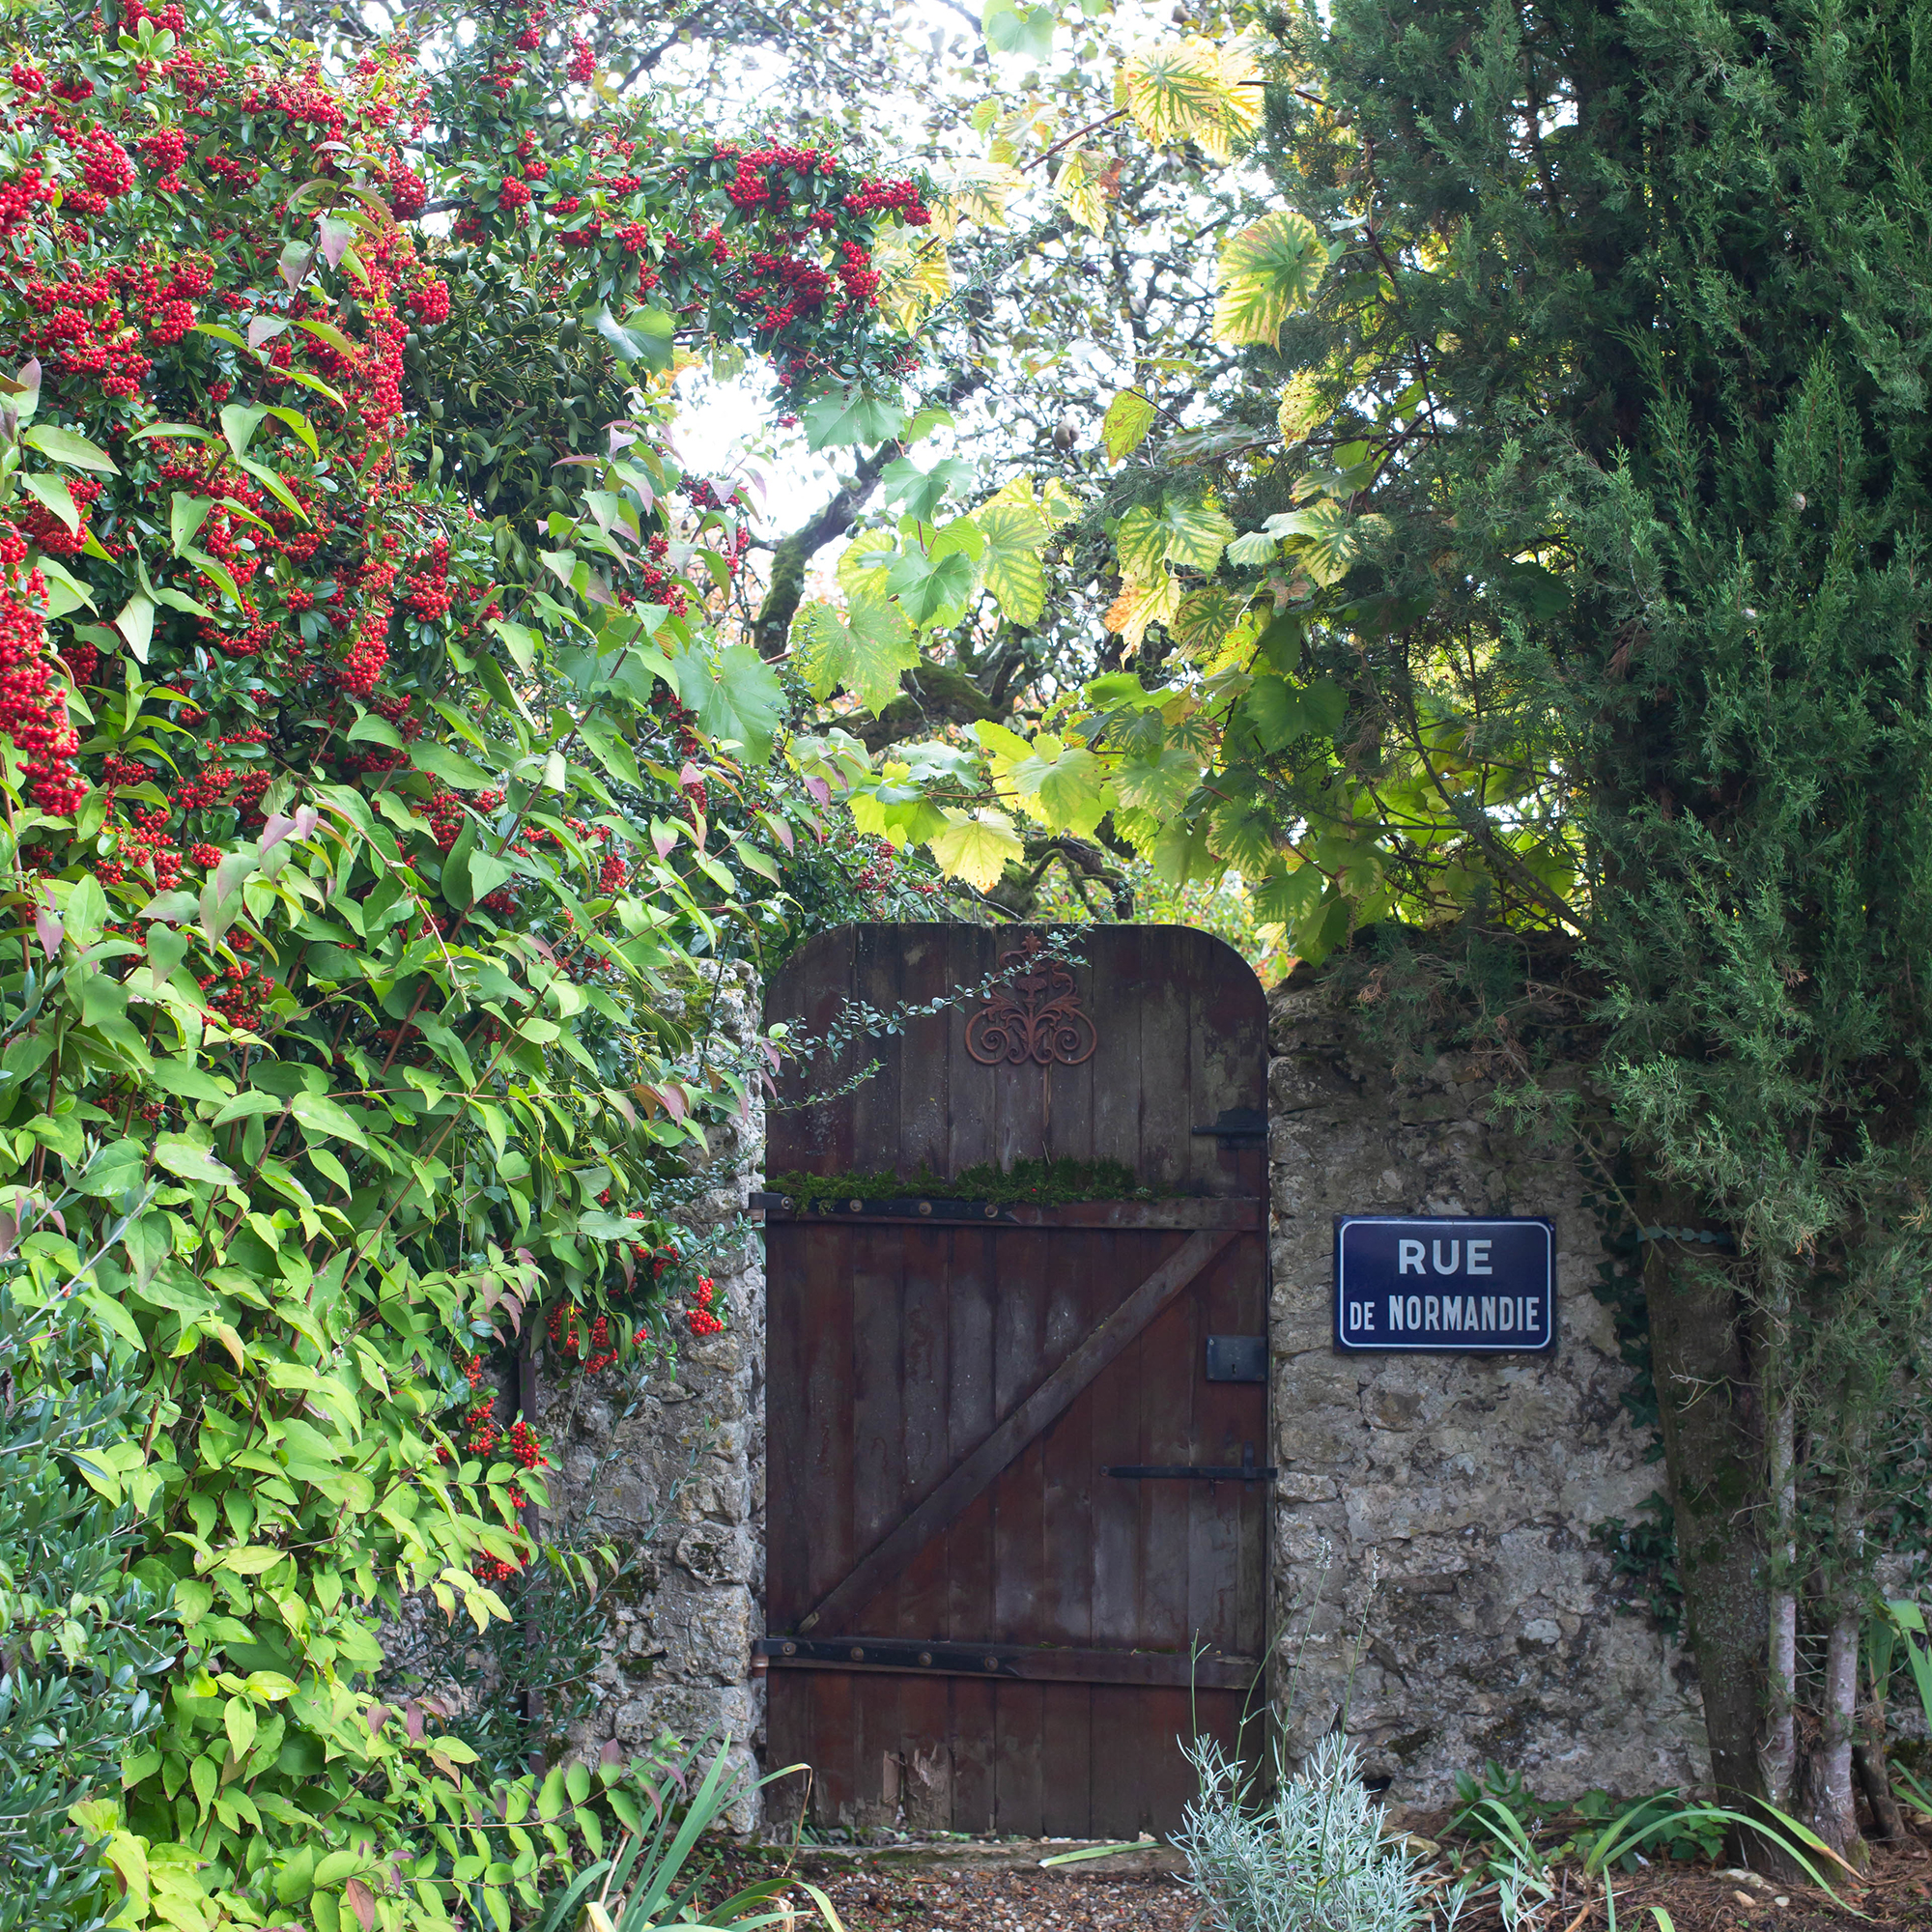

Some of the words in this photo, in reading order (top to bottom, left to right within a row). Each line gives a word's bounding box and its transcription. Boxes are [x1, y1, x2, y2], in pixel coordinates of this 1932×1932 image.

[1398, 1238, 1493, 1275] RUE
[1350, 1301, 1376, 1331] DE
[1388, 1294, 1541, 1332] NORMANDIE
